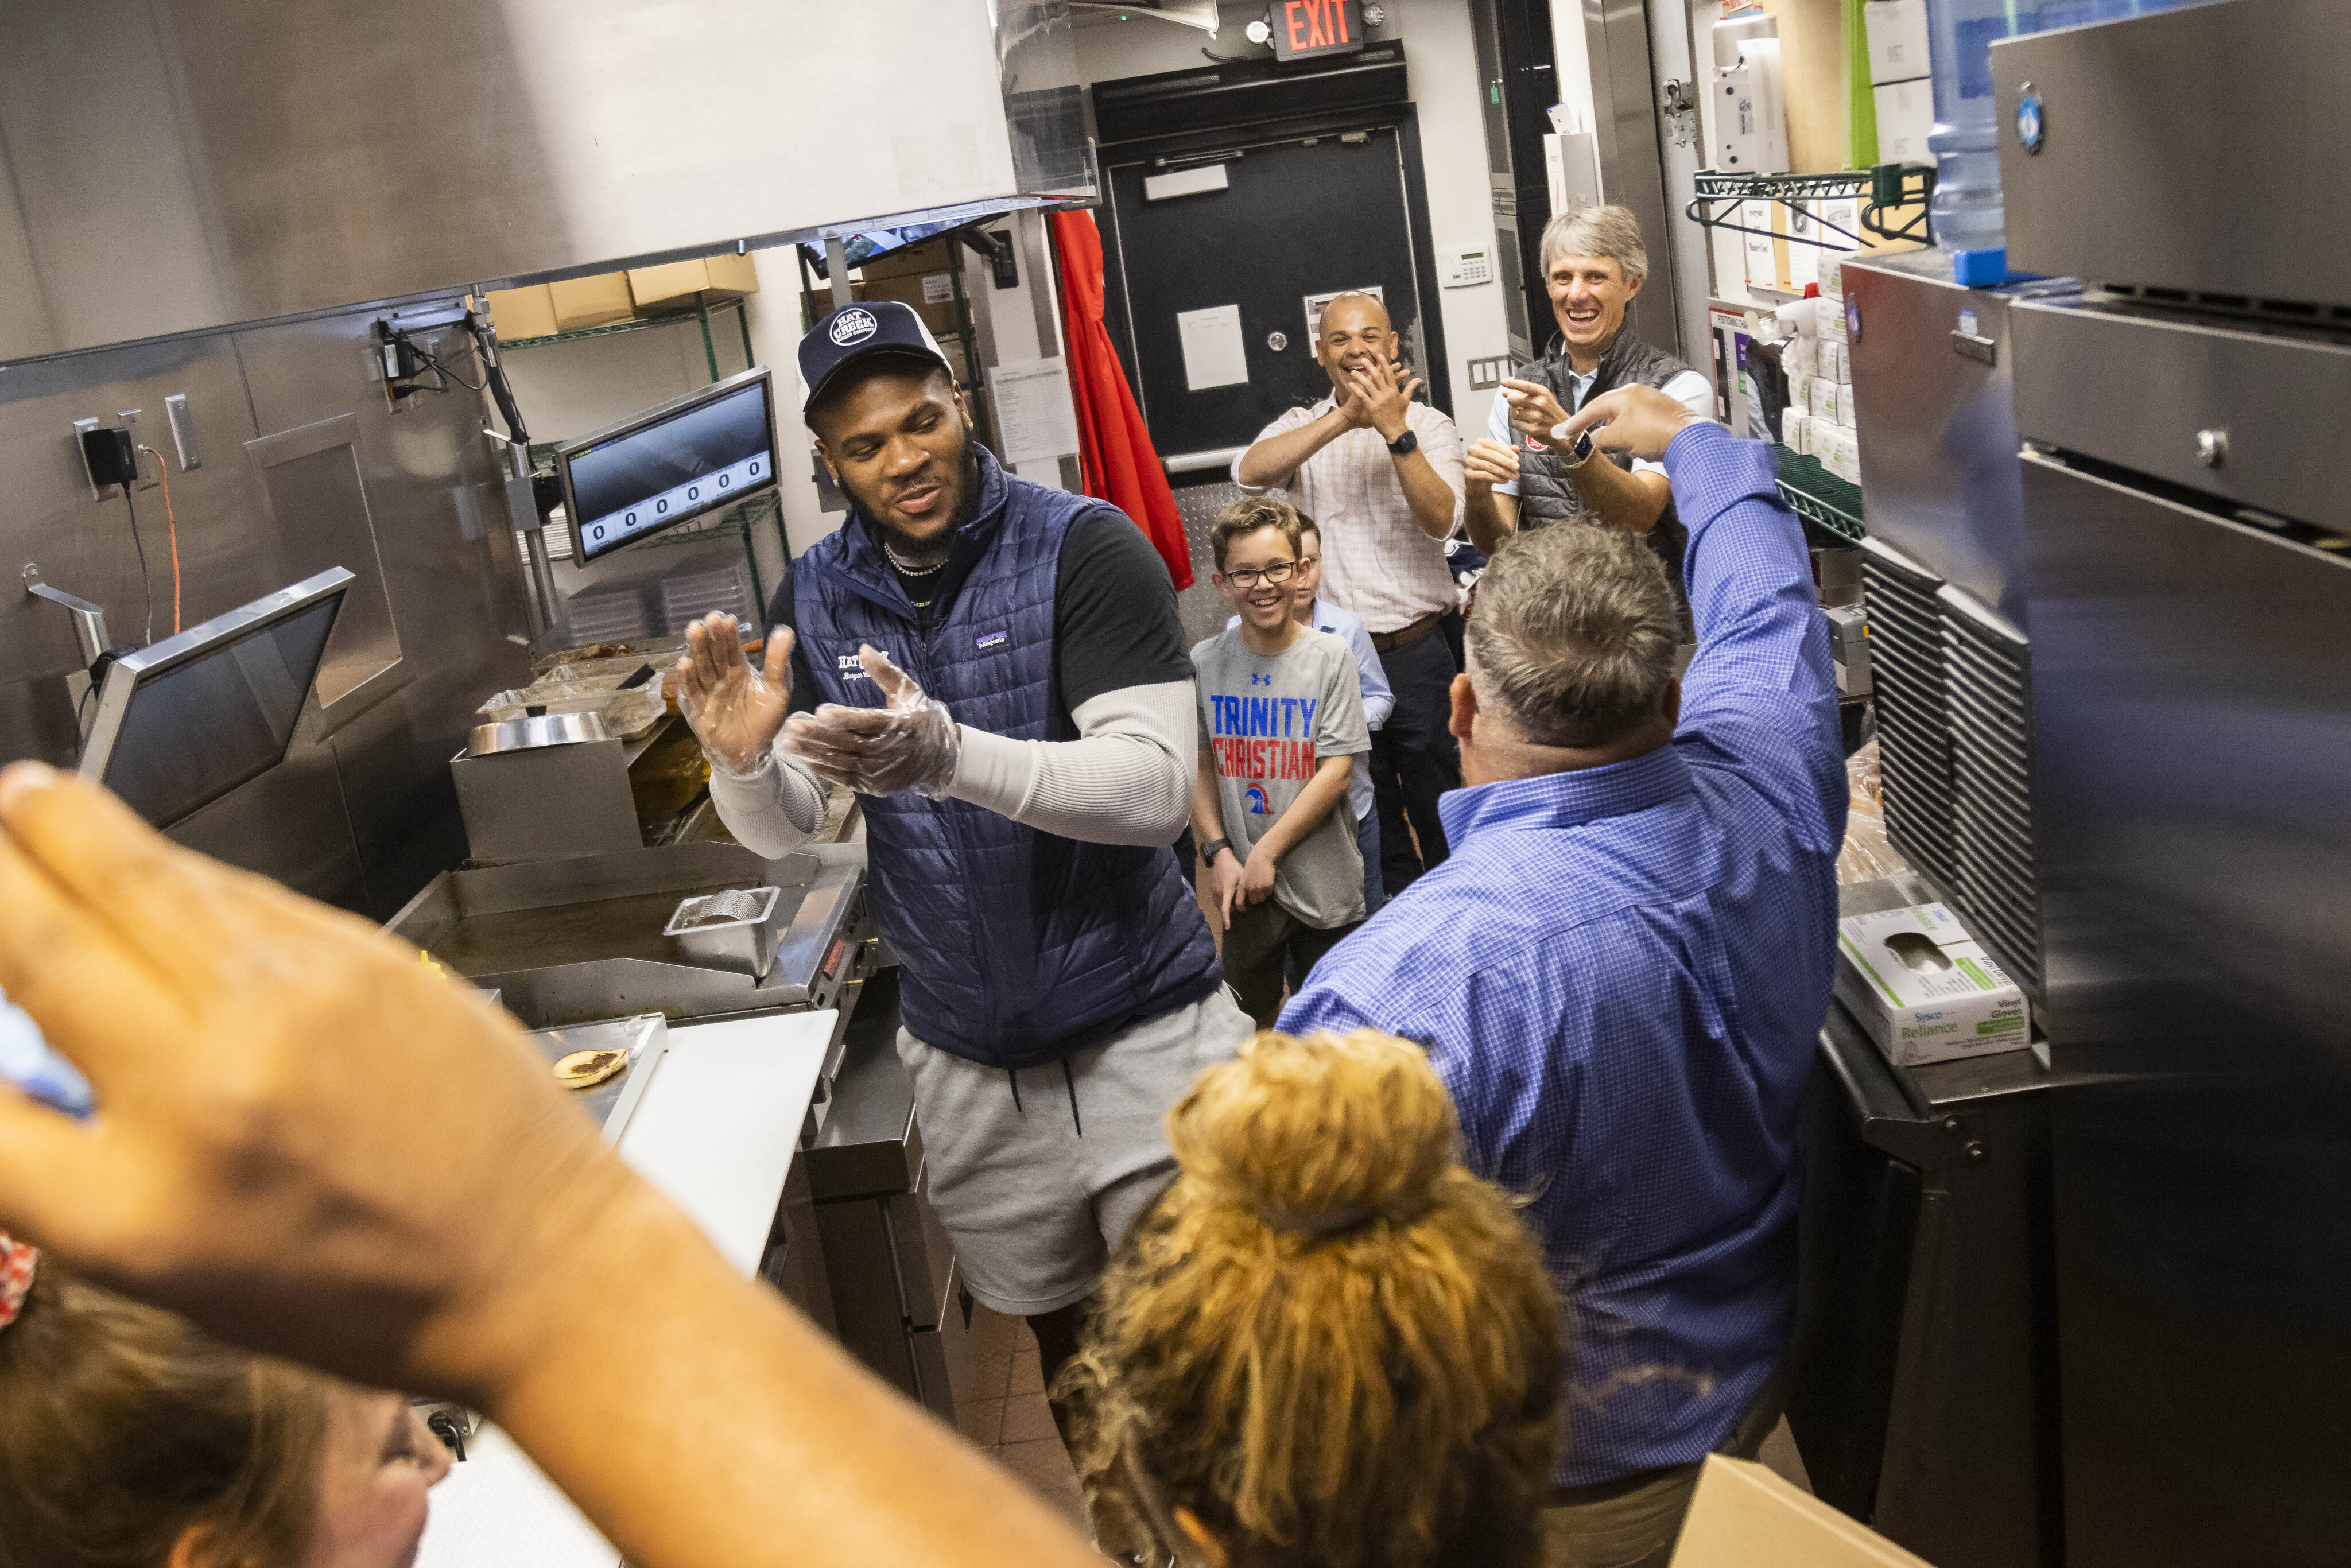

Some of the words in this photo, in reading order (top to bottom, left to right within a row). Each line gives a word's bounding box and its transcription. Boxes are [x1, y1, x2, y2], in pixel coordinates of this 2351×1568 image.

[1285, 0, 1349, 51] EXIT
[837, 311, 862, 328] HAT
[833, 317, 874, 339] CREEK
[853, 327, 874, 335] COMPANY
[749, 461, 760, 476] 0
[719, 473, 730, 488] 0
[688, 486, 699, 500] 0
[657, 499, 668, 514] 0
[625, 512, 637, 526] 0
[593, 525, 605, 540] 0
[979, 638, 1005, 649] patagonia
[838, 655, 859, 669] HAT
[843, 672, 863, 681] Burger
[1211, 695, 1317, 738] TRINITY
[1212, 738, 1315, 780] CHRISTIAN
[1909, 906, 1938, 931] Reliance
[1932, 910, 1949, 922] Sysco
[1998, 998, 2022, 1008] Vinyl
[1915, 1012, 1943, 1023] Sysco
[1991, 1008, 2023, 1019] Gloves
[1902, 1023, 1958, 1039] Reliance
